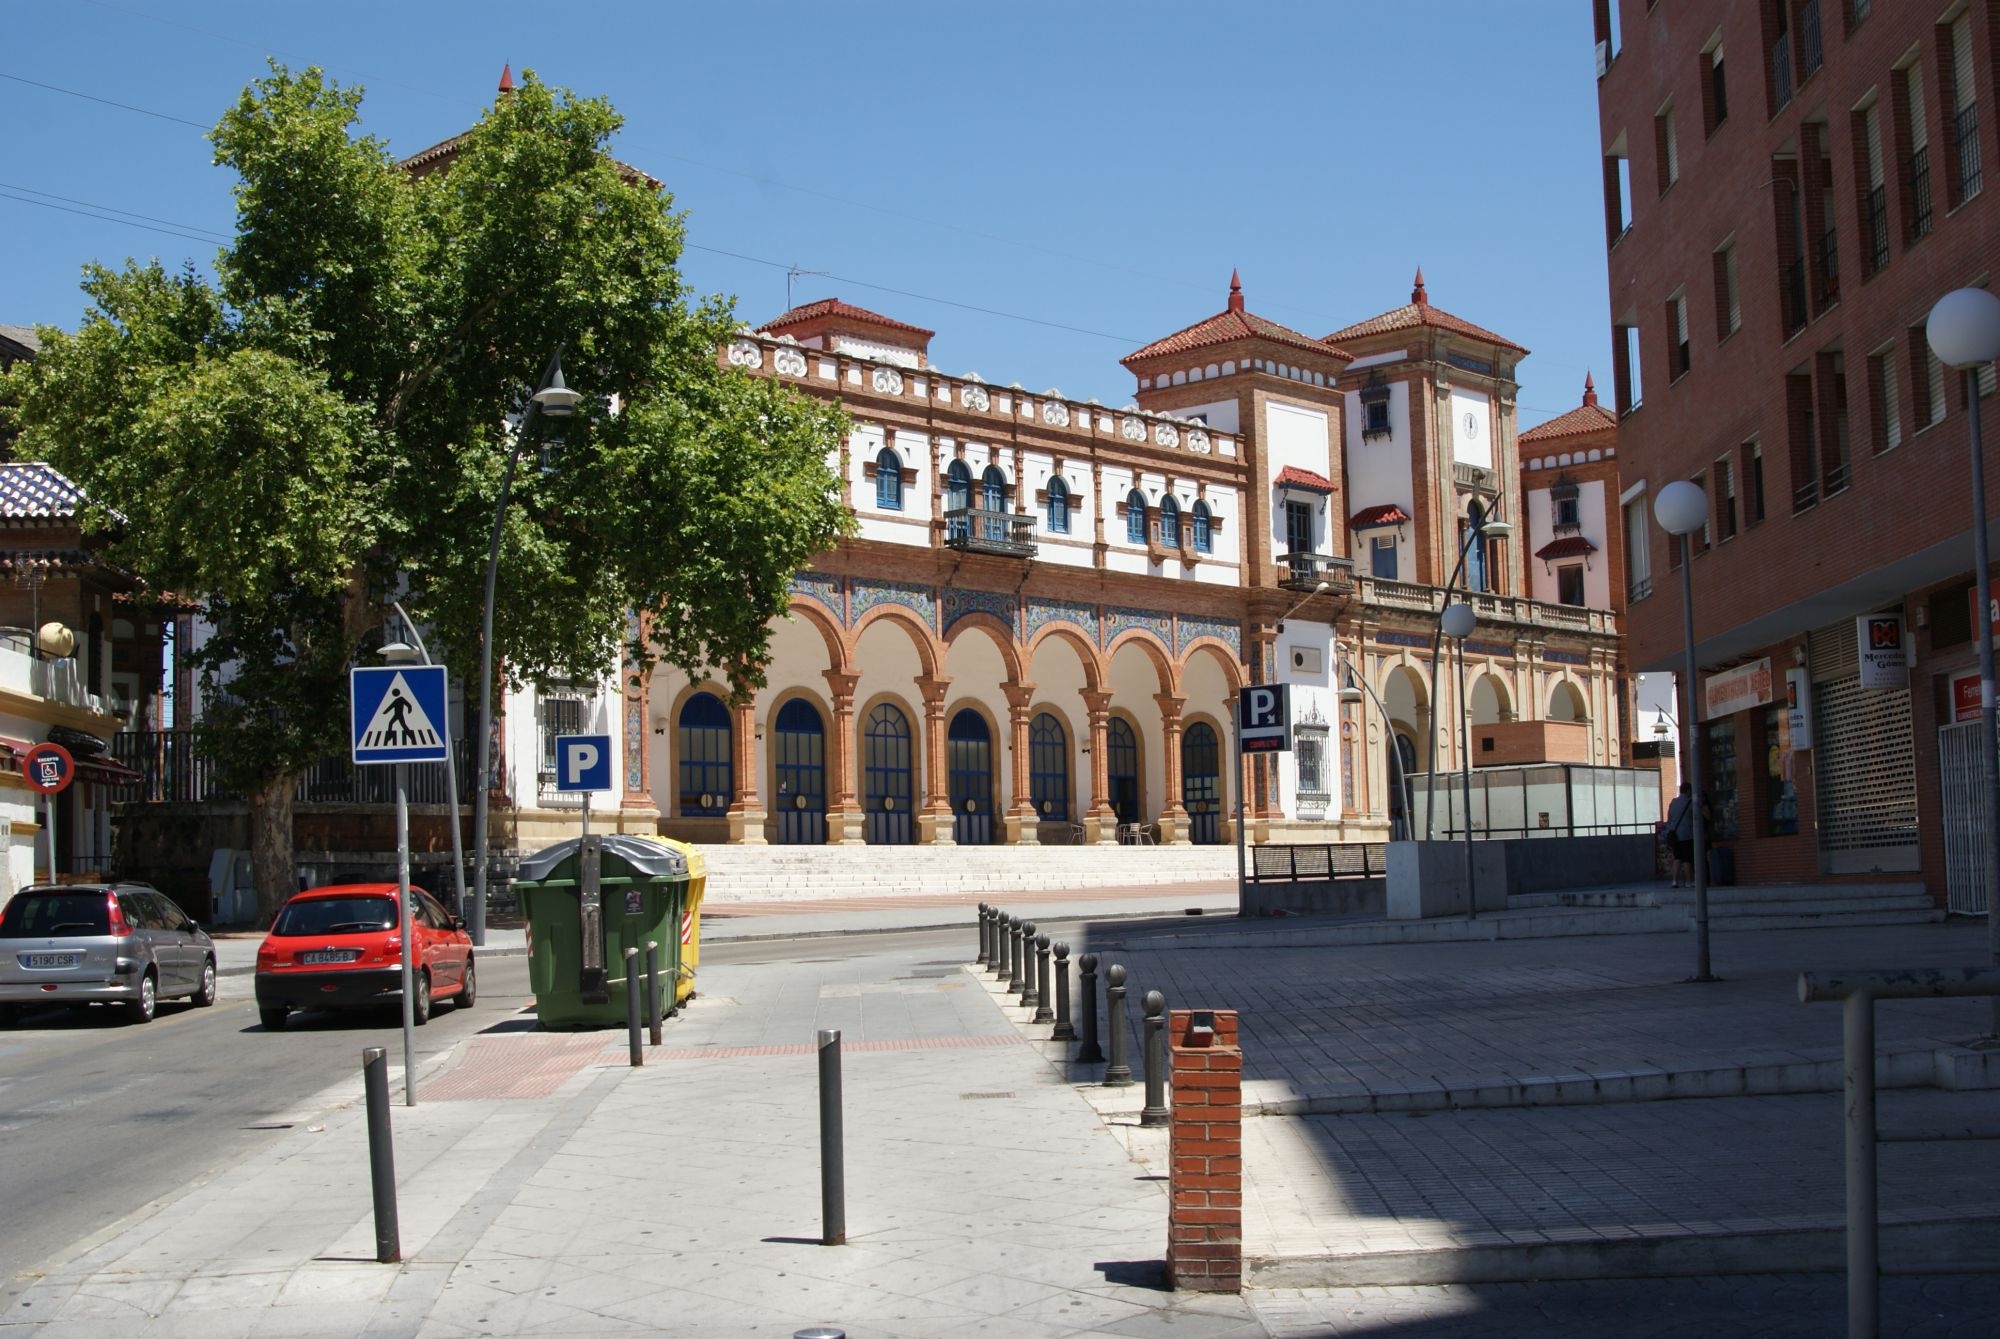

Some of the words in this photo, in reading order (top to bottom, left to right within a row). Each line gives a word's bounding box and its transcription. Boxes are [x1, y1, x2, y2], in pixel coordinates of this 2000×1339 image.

[1251, 689, 1275, 725] P
[568, 744, 599, 783] P
[32, 956, 55, 966] 5190
[57, 955, 74, 965] CSR
